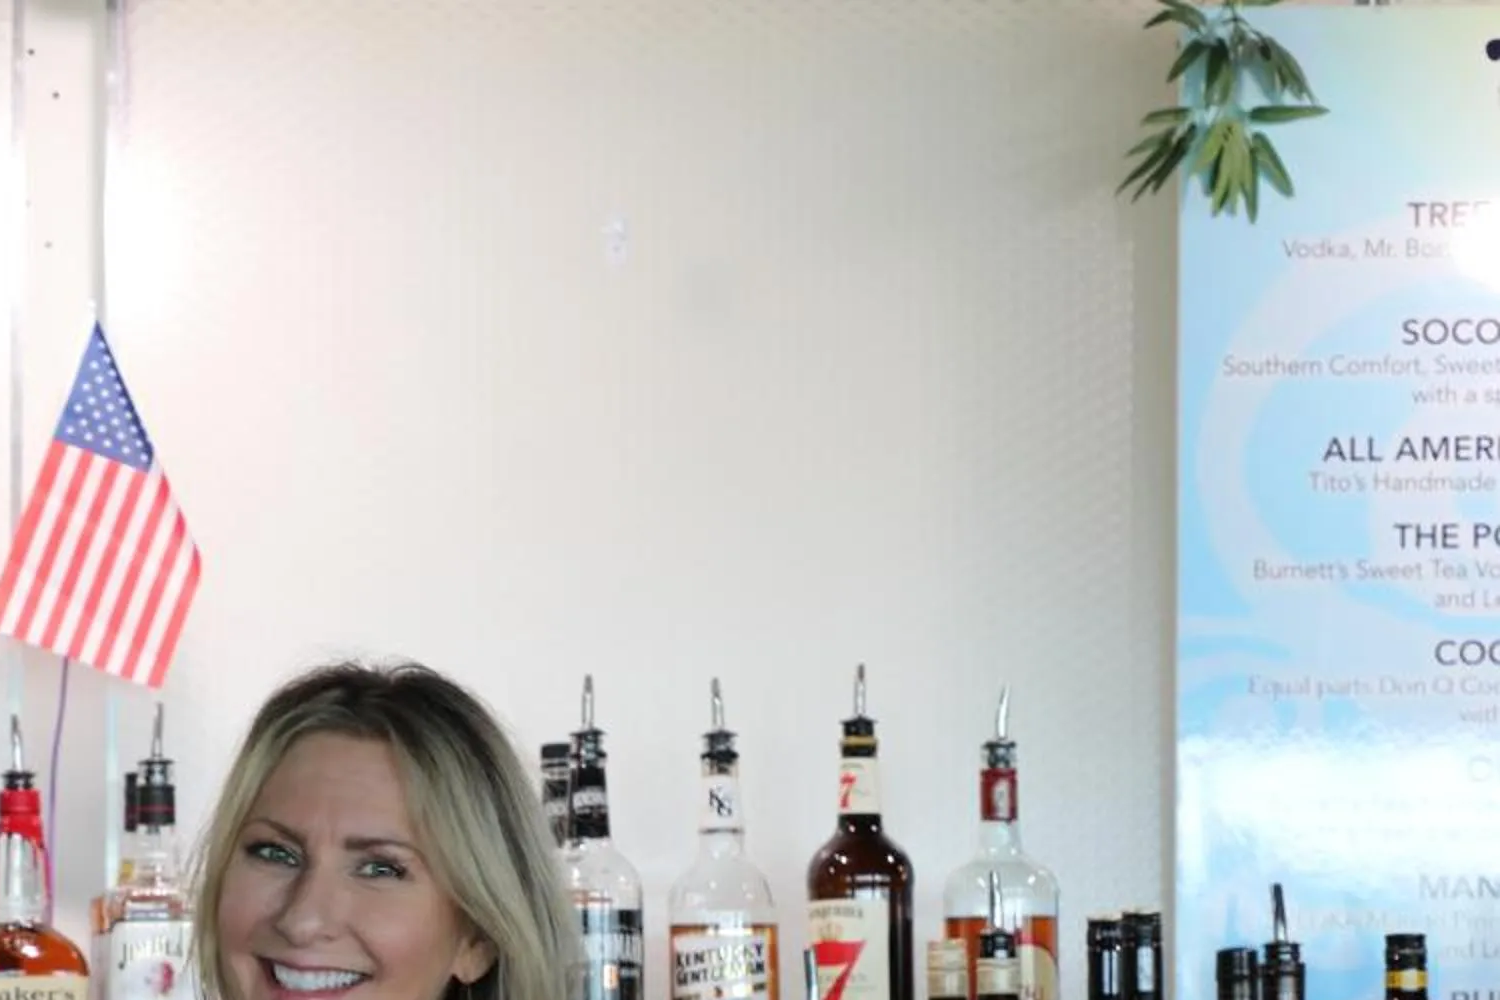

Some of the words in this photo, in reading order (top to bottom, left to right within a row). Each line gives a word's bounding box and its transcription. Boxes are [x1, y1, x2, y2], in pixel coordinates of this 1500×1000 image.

[1282, 236, 1358, 262] Vodka,
[1363, 238, 1398, 259] Mr.
[1222, 354, 1323, 377] Southern
[1411, 386, 1457, 406] with
[1463, 390, 1478, 405] a
[1321, 435, 1385, 464] ALL
[1307, 470, 1368, 493] Tito's
[1372, 470, 1497, 493] Handmade
[1392, 521, 1461, 551] THE
[1253, 558, 1350, 582] Burnett's
[1355, 559, 1423, 582] Sweet
[1430, 558, 1468, 581] Tea
[1434, 590, 1476, 609] and
